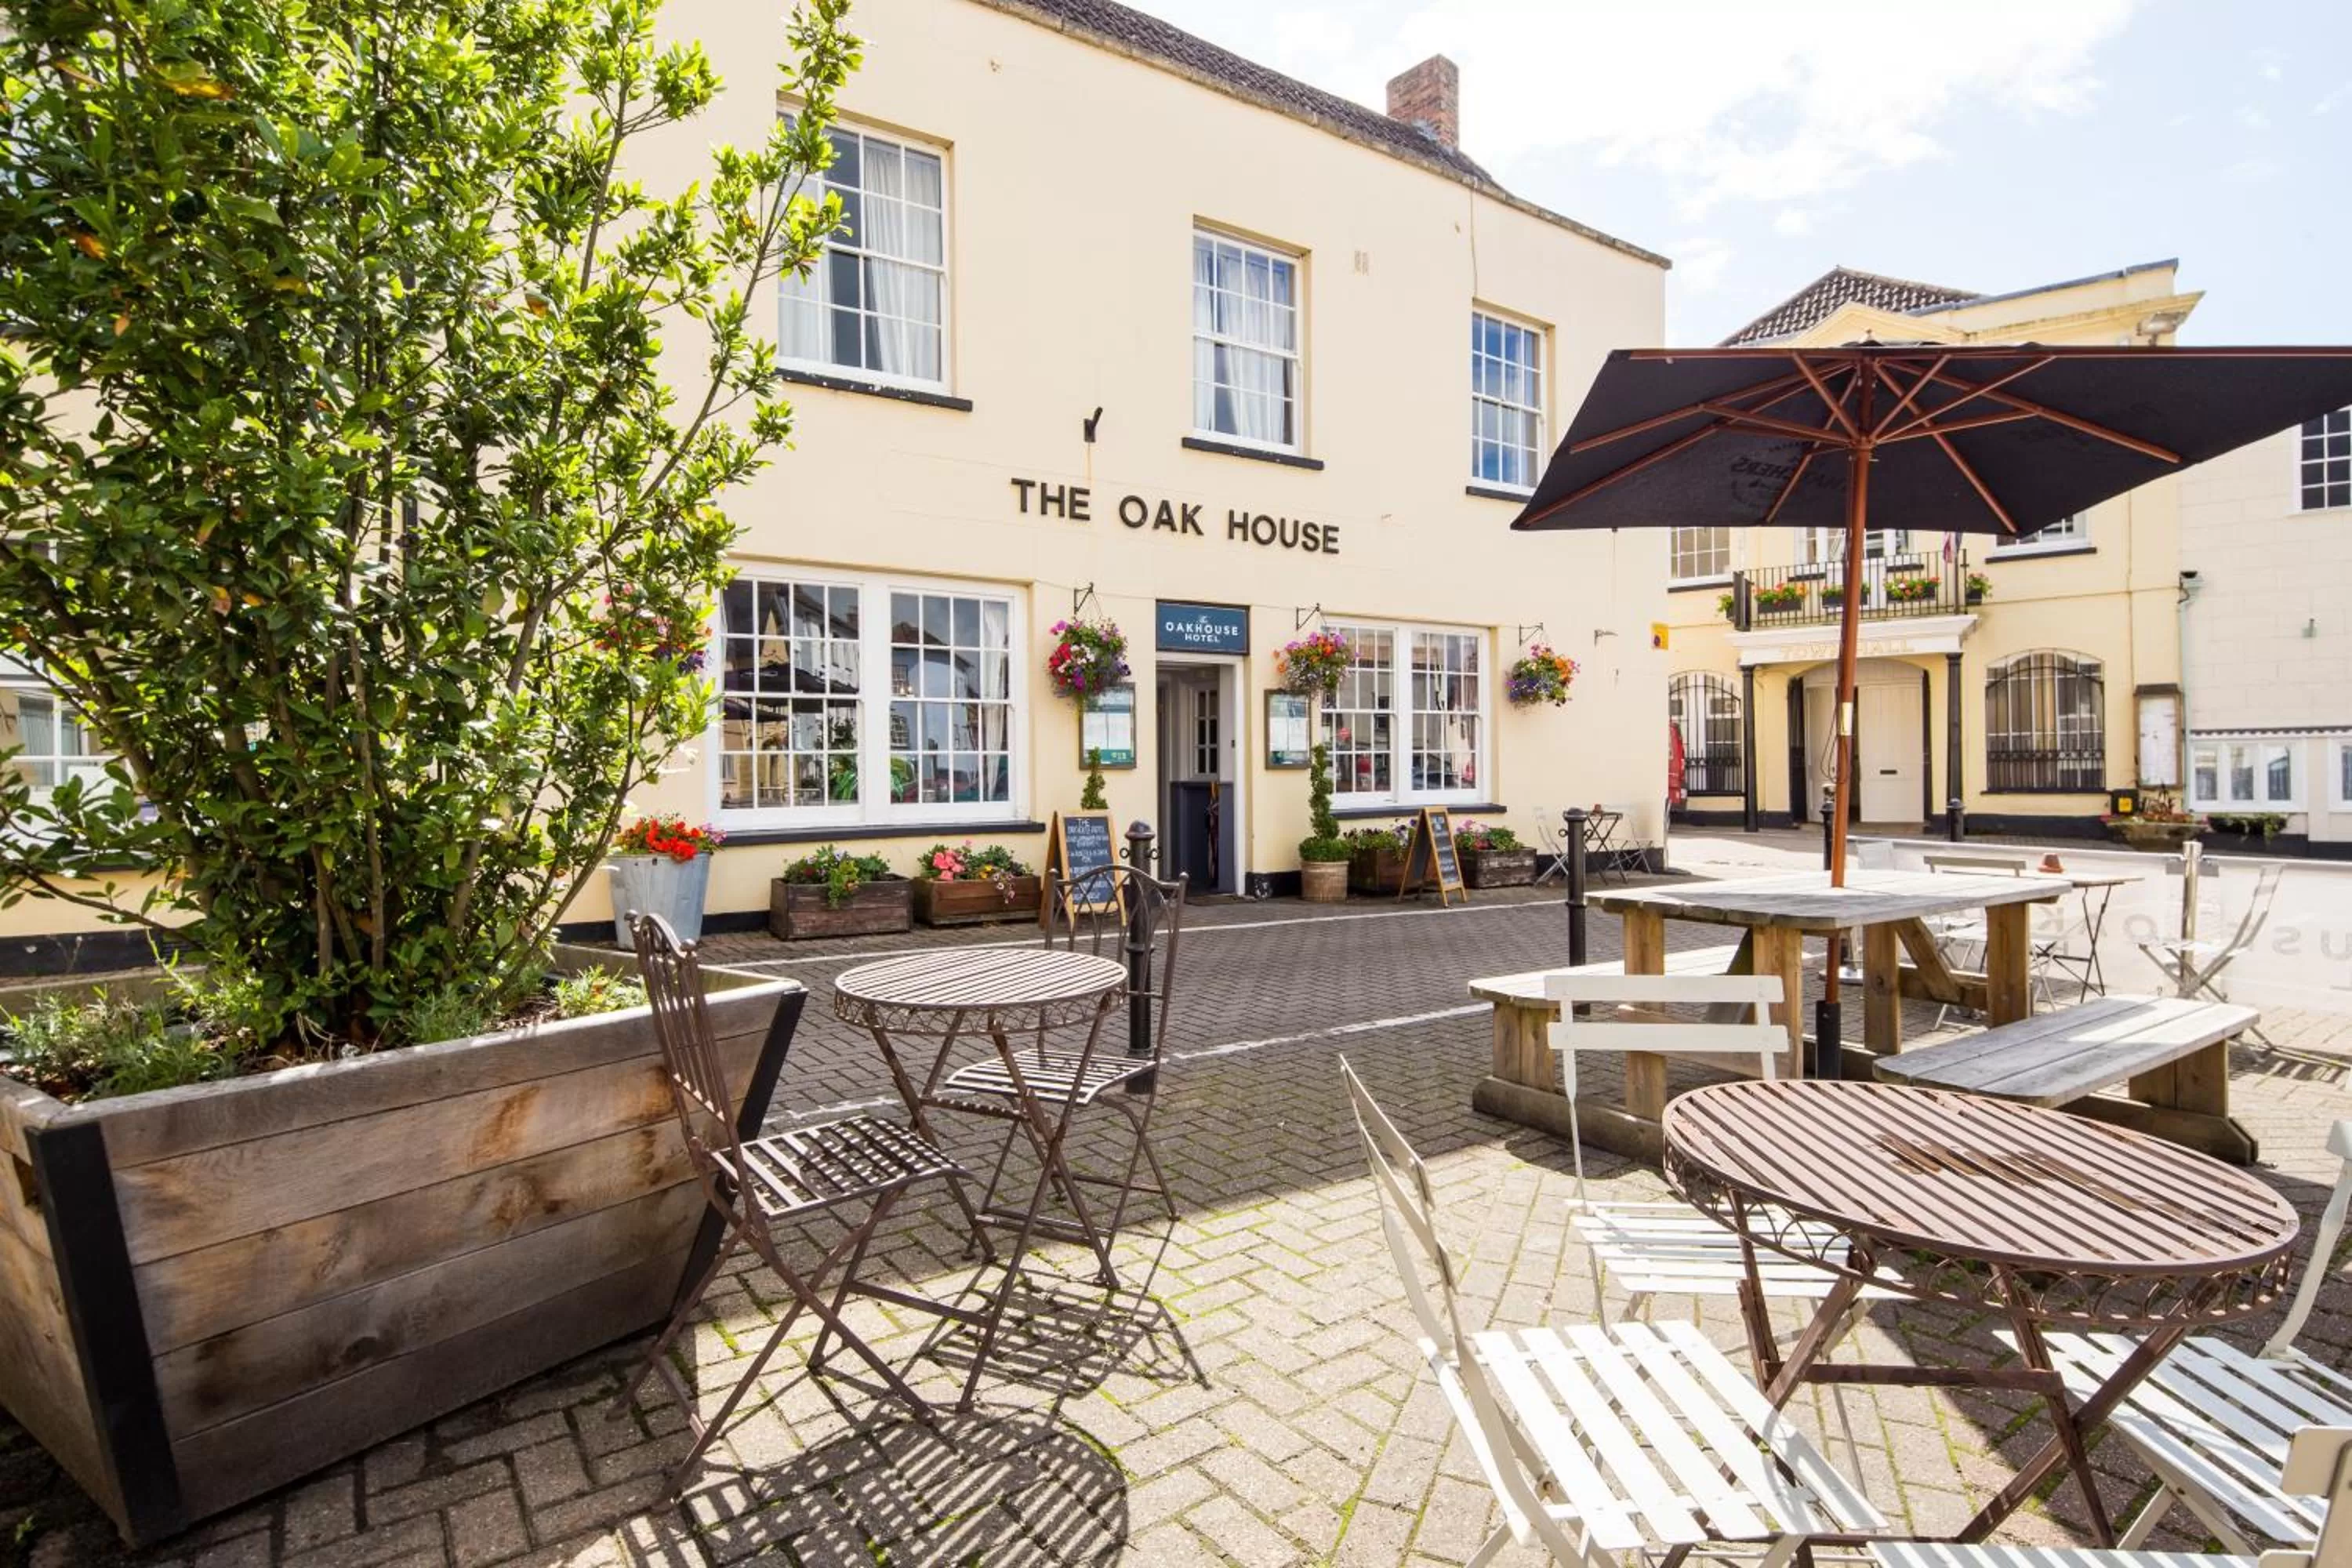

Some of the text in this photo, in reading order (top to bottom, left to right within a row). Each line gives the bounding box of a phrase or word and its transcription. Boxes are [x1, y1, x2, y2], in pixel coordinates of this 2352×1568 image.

[1011, 477, 1340, 554] THE OAK HOUSE
[1165, 622, 1239, 636] OAKHOUSE
[1185, 633, 1221, 643] HOTEL
